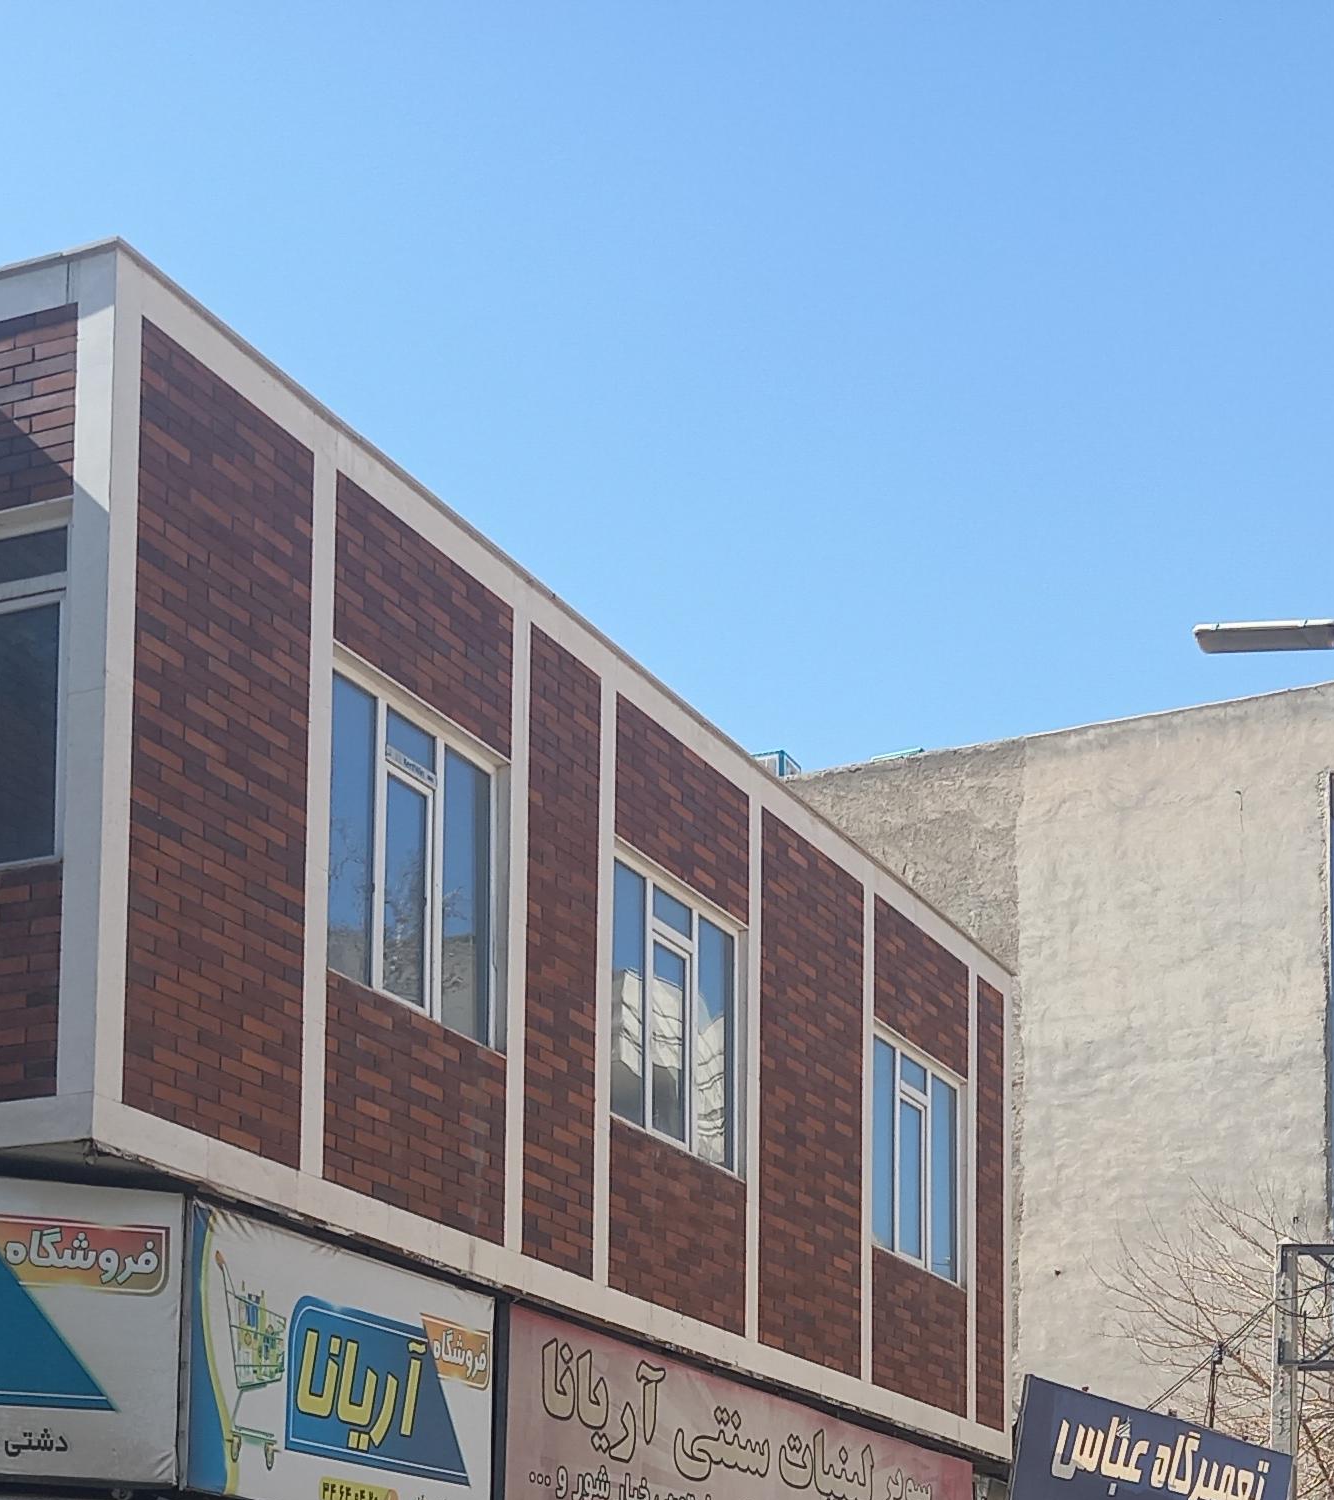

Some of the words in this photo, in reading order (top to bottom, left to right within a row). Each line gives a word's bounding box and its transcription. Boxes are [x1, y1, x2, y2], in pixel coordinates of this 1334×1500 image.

[4, 1227, 160, 1285] فروشگاه
[296, 1328, 427, 1452] آریانا
[433, 1328, 487, 1378] فروشگاه
[542, 1338, 666, 1463] آریانا
[4, 1428, 68, 1455] دشتی
[674, 1405, 770, 1481] سنتی
[1051, 1415, 1151, 1497] عباس
